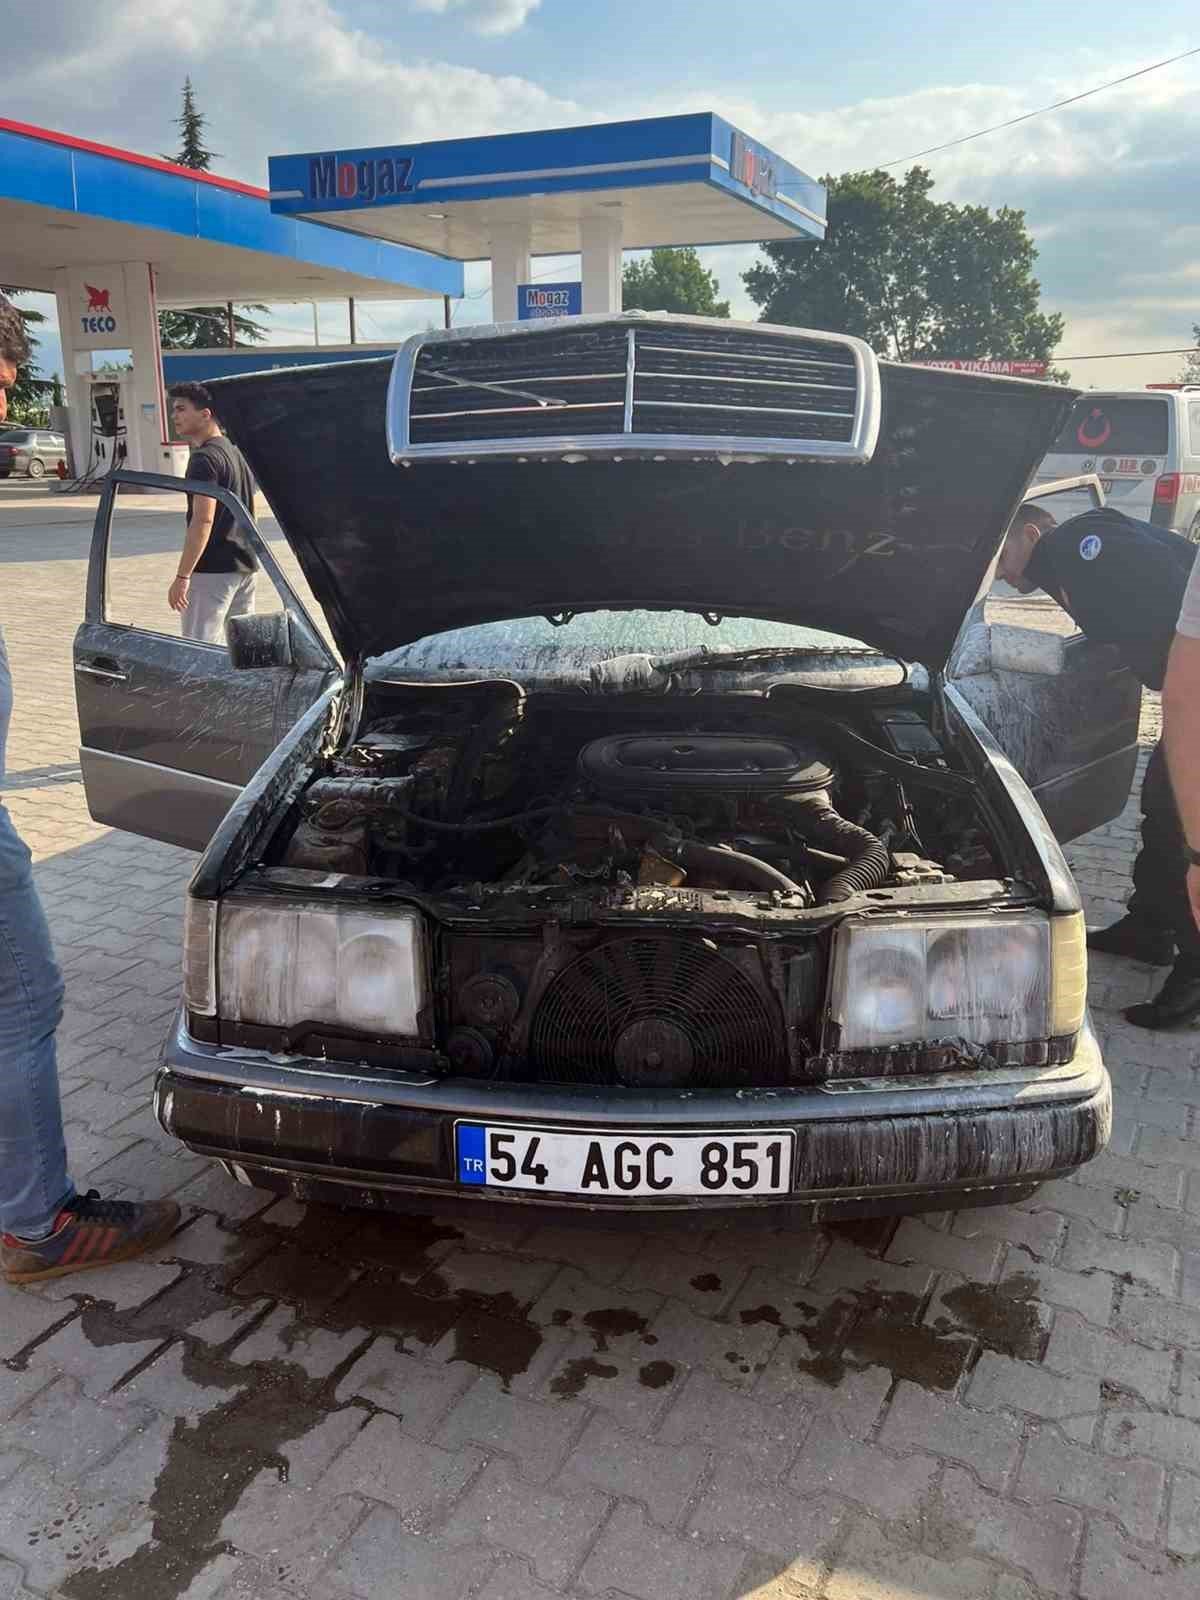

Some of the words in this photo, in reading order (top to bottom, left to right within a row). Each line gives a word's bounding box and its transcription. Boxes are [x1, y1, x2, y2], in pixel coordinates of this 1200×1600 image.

[308, 155, 415, 201] Mogaz
[526, 289, 569, 309] Mogaz
[81, 316, 116, 333] TECO
[959, 361, 1009, 375] YIKAMA
[463, 1157, 484, 1173] TR
[489, 1133, 549, 1185] 54
[580, 1141, 674, 1191] AGC
[700, 1141, 782, 1190] 851
